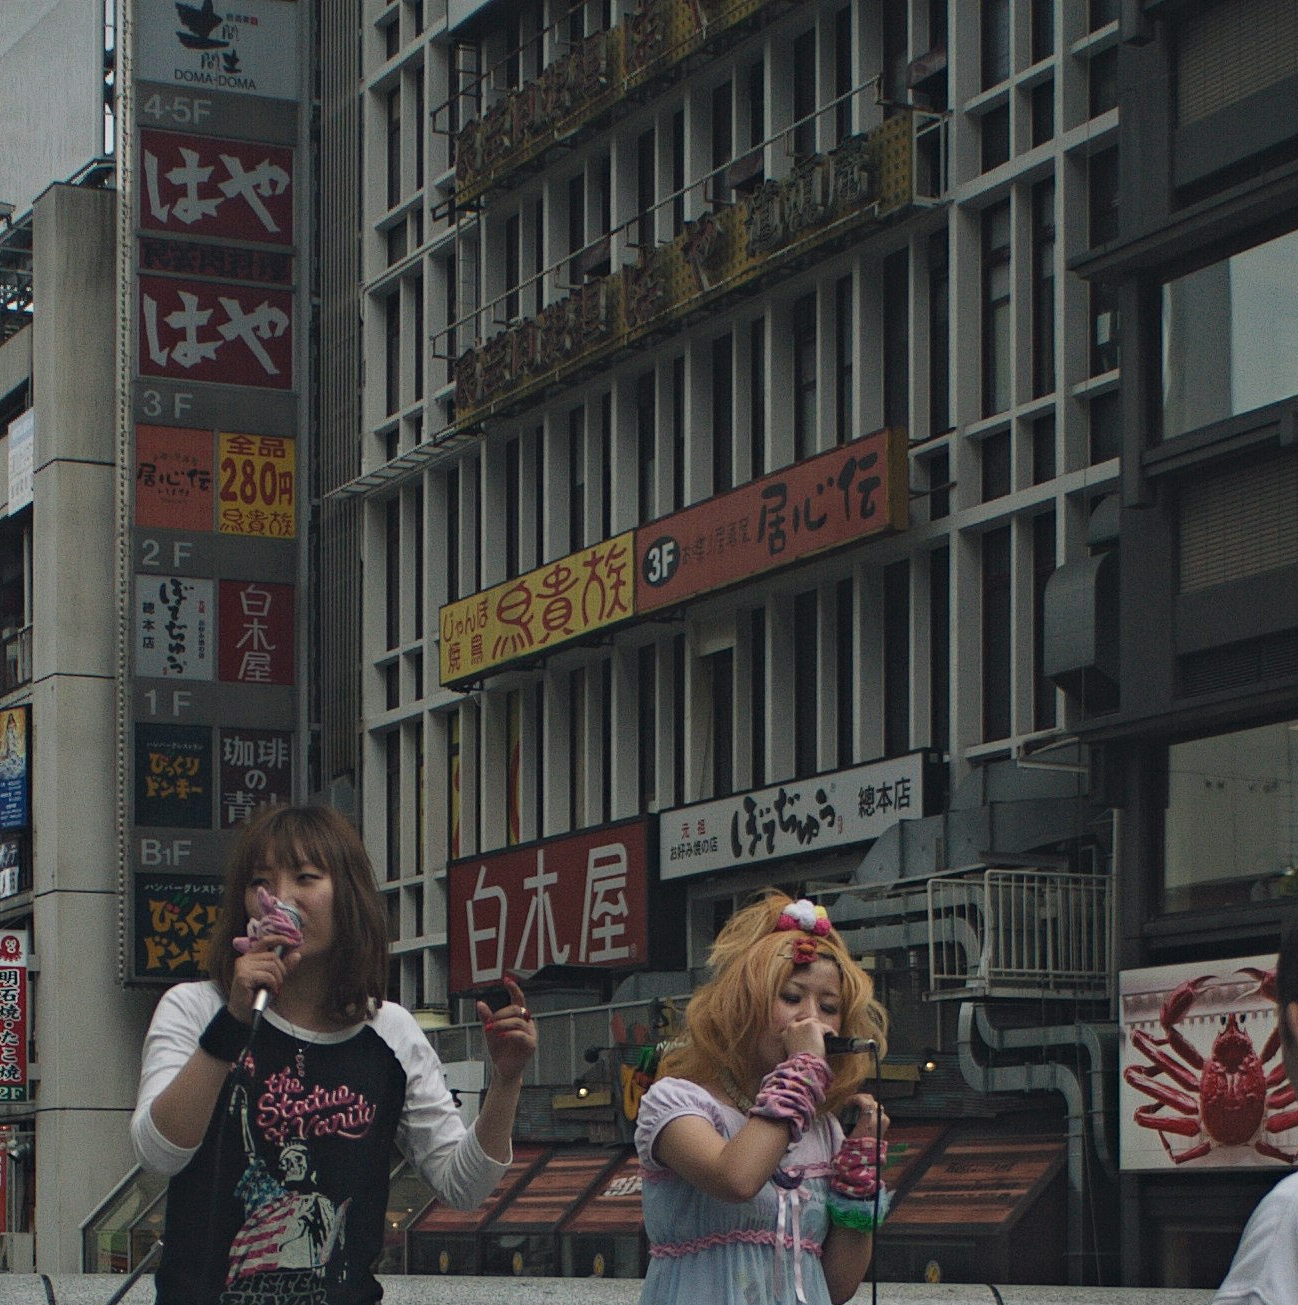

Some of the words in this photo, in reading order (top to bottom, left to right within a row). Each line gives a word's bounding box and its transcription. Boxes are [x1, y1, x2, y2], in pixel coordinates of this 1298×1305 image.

[175, 69, 256, 90] DOMA-DOMA
[144, 147, 290, 232] はや
[143, 290, 289, 375] はや
[227, 435, 286, 459] 全品
[137, 462, 211, 490] 居心伝
[220, 457, 293, 506] 280円
[758, 452, 881, 556] 居心伝
[647, 540, 674, 582] 3F
[491, 544, 628, 660] 鳥貴族
[235, 584, 277, 683] 白木屋
[148, 752, 201, 777] びっくり
[223, 736, 289, 769] 珈琲
[144, 775, 203, 800] ドンキー
[245, 769, 267, 790] の
[465, 842, 631, 984] 白木屋
